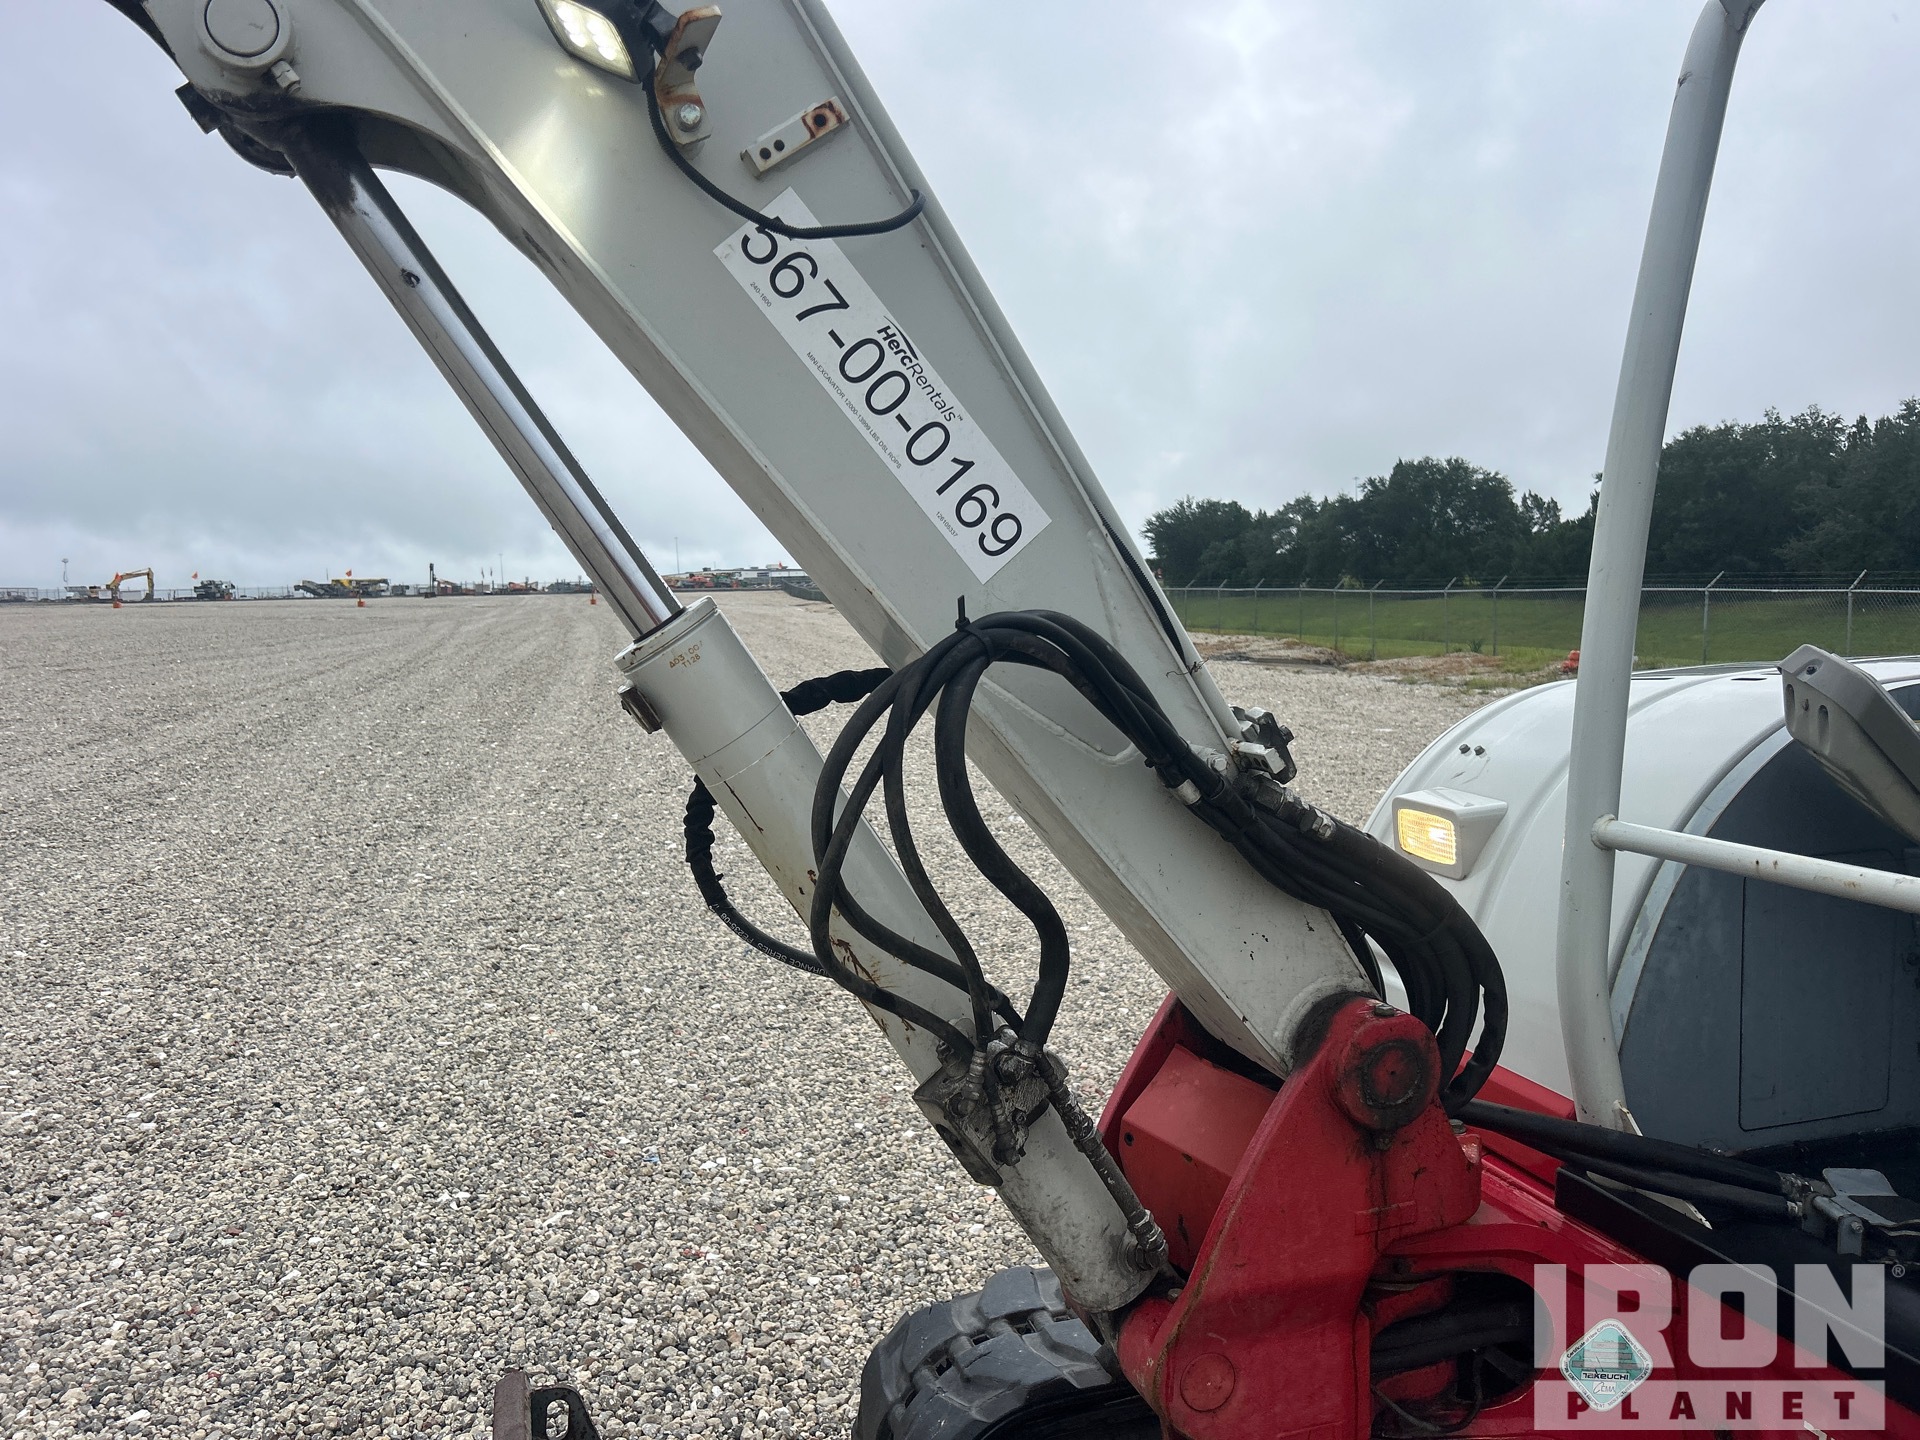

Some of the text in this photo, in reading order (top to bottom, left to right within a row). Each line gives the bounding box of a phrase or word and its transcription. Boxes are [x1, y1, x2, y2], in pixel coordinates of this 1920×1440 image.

[741, 216, 1023, 556] 567-00-0169
[805, 350, 847, 400] MINI-EXCAVATOR
[868, 428, 881, 442] LBS
